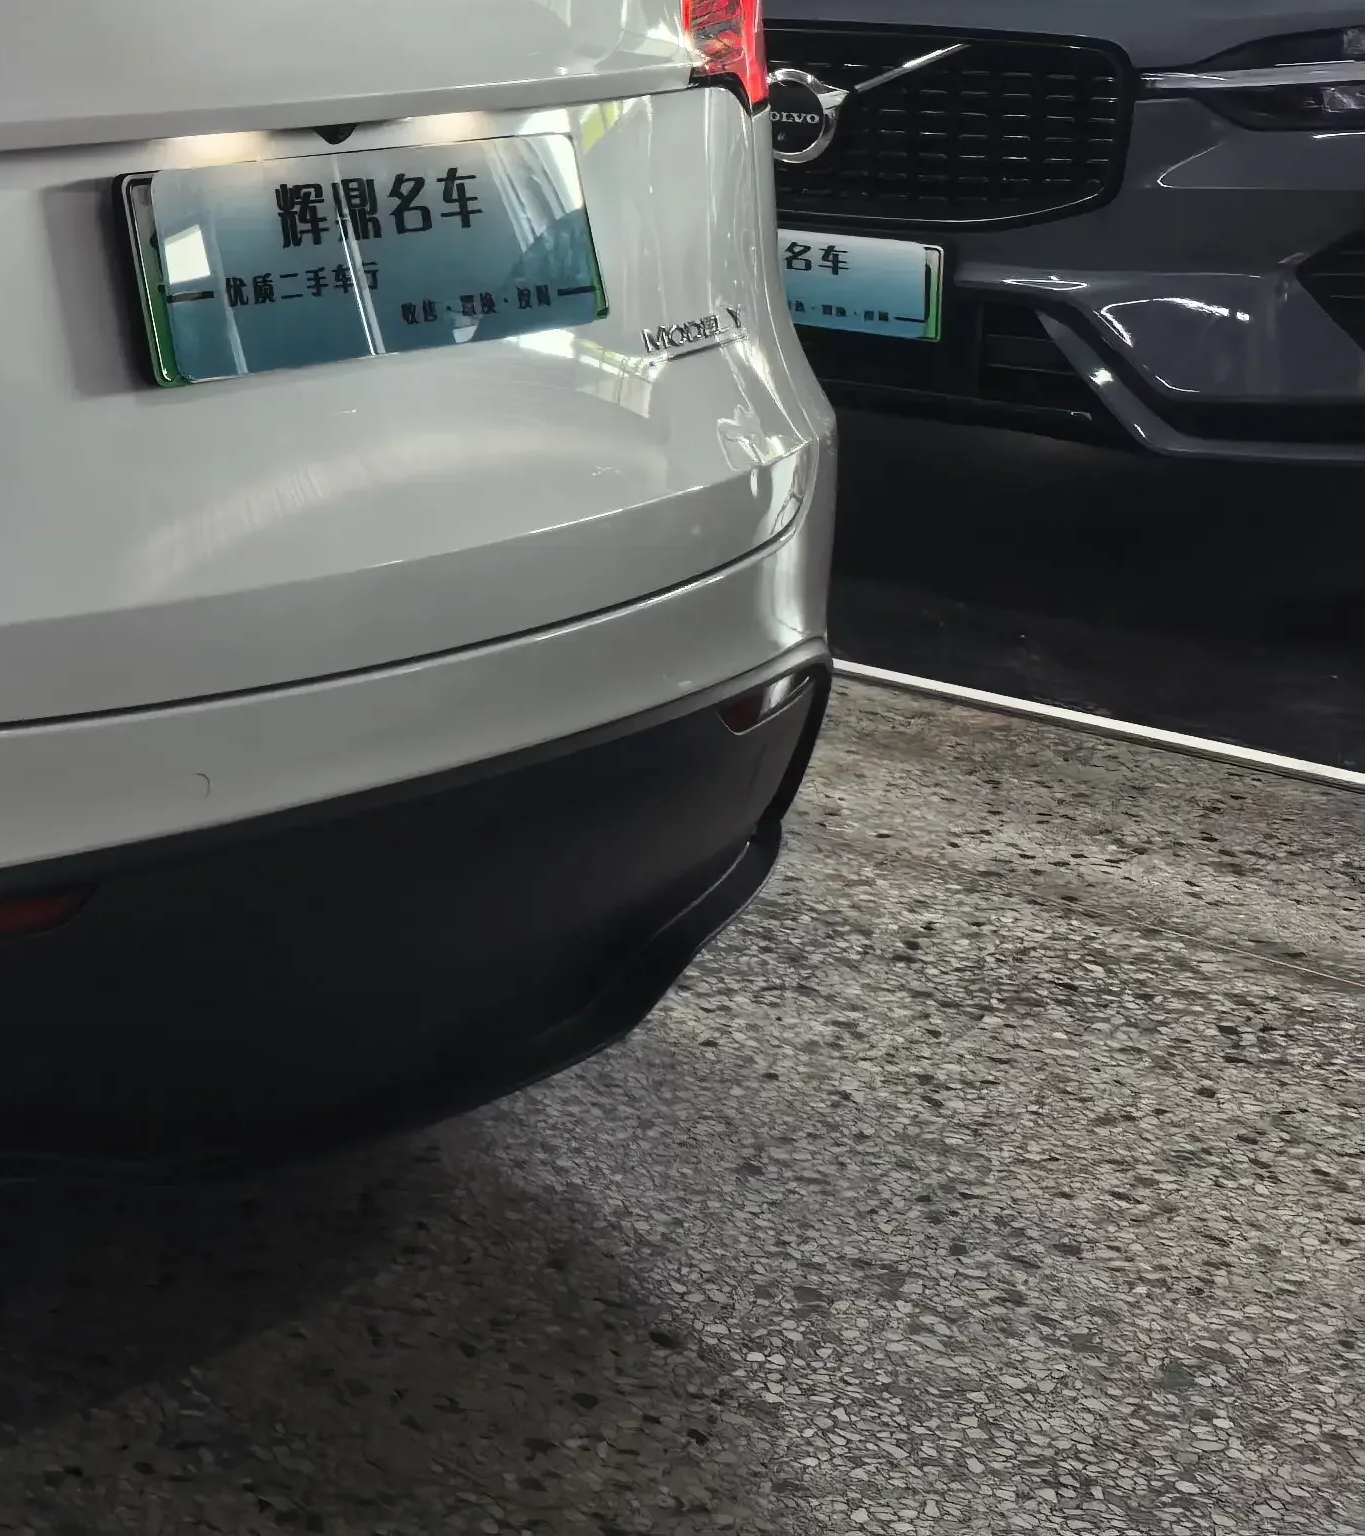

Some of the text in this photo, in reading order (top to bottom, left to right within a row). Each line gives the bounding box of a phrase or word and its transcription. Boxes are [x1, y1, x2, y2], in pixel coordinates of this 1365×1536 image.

[770, 112, 820, 125] OLVO
[275, 167, 483, 249] 辉鼎名车
[785, 241, 851, 275] 名车
